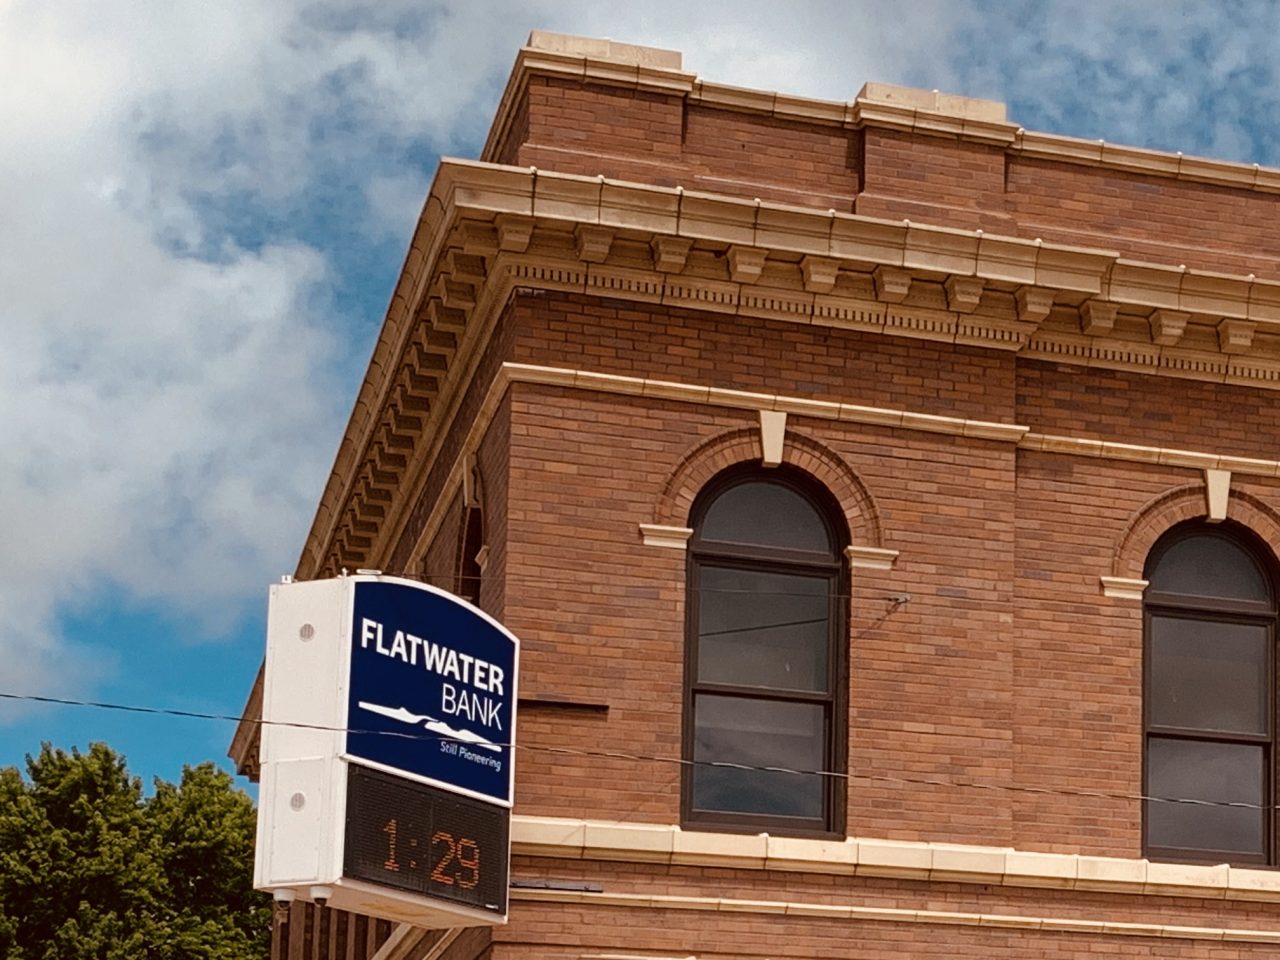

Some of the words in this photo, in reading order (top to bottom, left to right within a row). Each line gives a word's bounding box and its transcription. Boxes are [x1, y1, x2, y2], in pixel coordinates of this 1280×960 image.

[361, 617, 505, 696] FLATWATER
[442, 683, 504, 731] BANK
[440, 741, 458, 758] Still
[459, 745, 502, 772] Pioneering
[384, 818, 481, 890] 1:29
